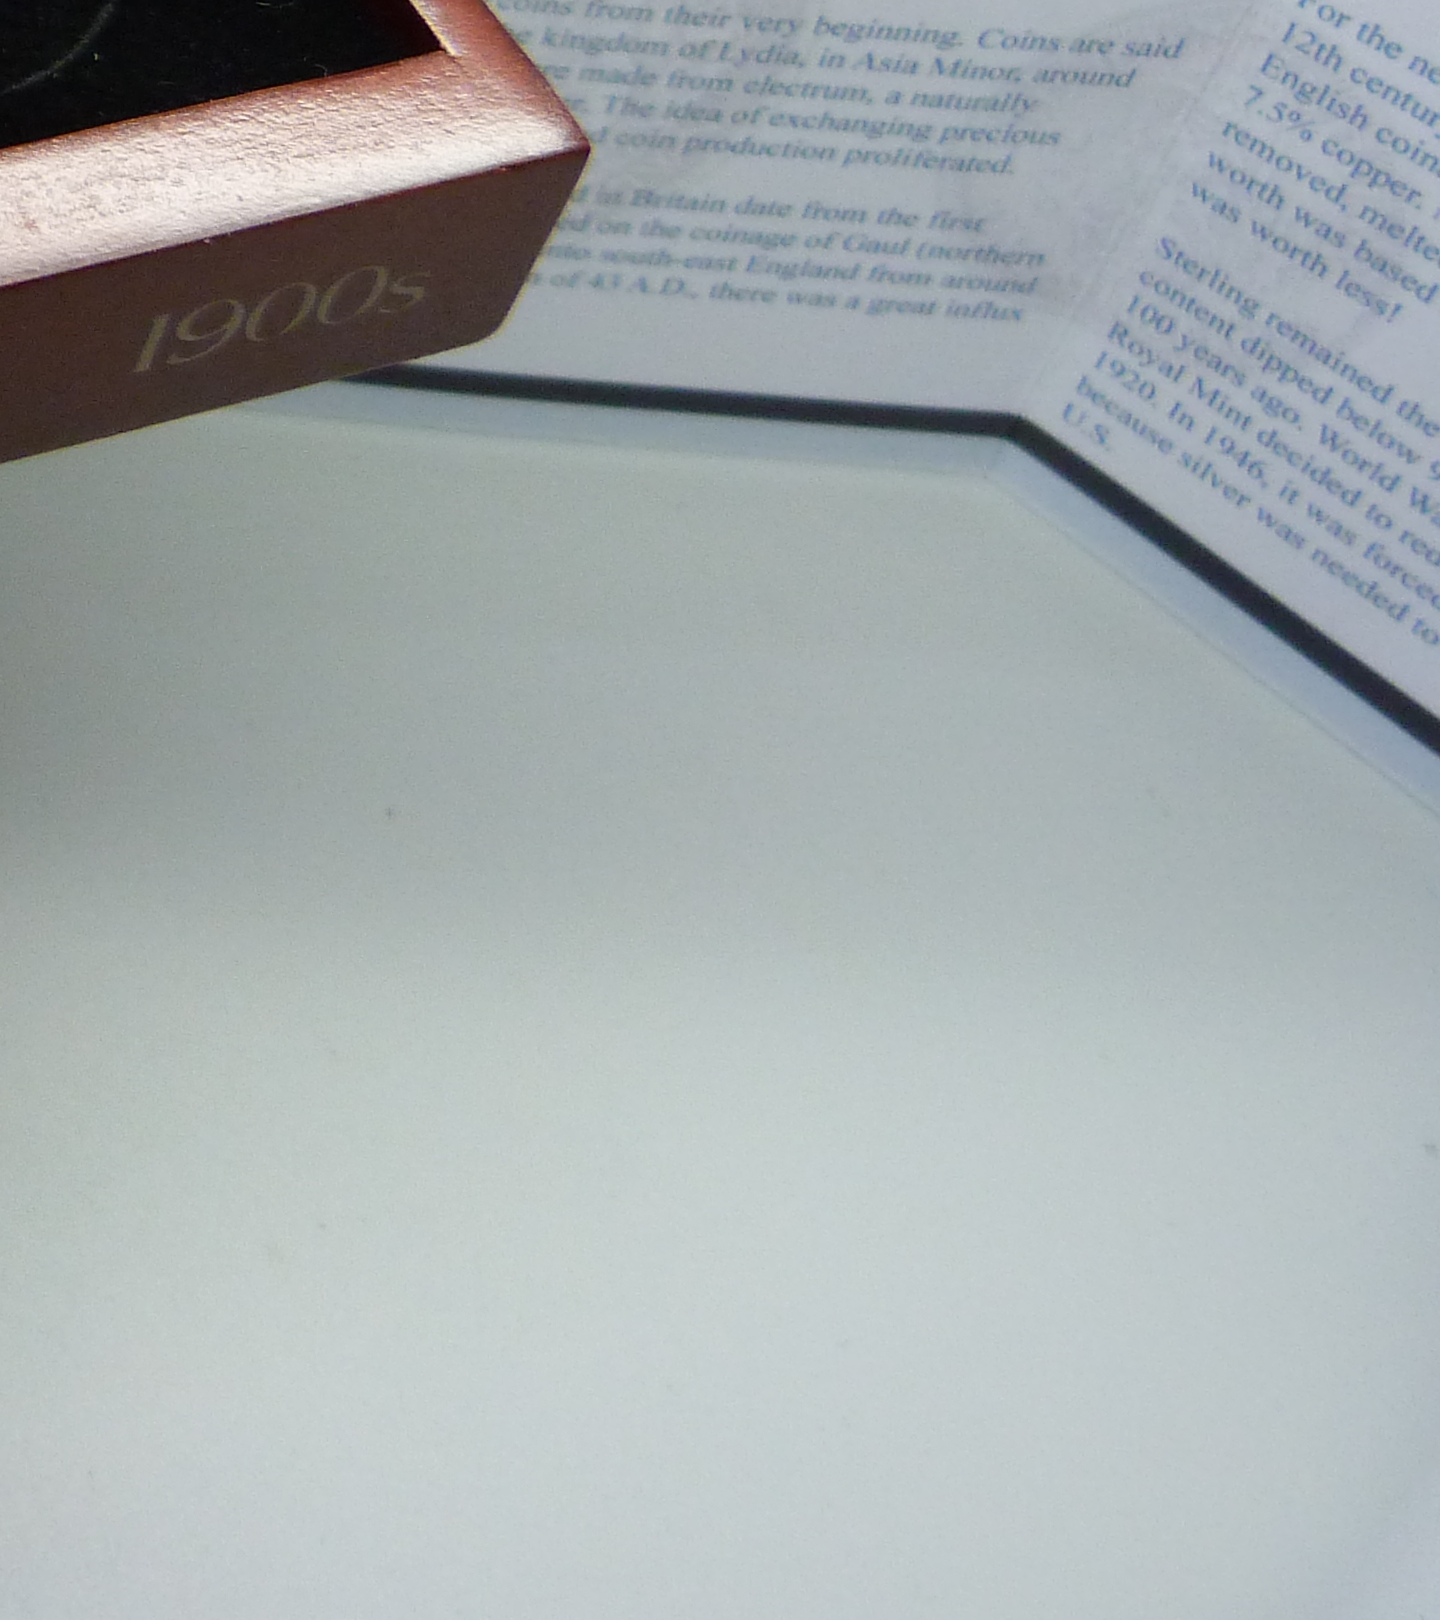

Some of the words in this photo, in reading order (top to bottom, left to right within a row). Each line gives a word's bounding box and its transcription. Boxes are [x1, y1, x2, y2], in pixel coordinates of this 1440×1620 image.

[1260, 53, 1368, 130] English
[1283, 22, 1343, 72] 12th
[1357, 23, 1404, 59] the
[133, 266, 434, 373] 1900s
[1193, 182, 1240, 223] was
[1252, 221, 1328, 278] worth
[1336, 270, 1403, 320] less!
[1140, 272, 1235, 340] content
[1241, 338, 1334, 403] dipped
[1337, 398, 1421, 464] below
[1156, 237, 1261, 319] Sterling
[1266, 313, 1395, 404] remained
[1108, 322, 1185, 381] Royal
[1191, 377, 1252, 431] Mint
[1258, 431, 1363, 505] decided
[1366, 504, 1393, 530] to
[1128, 295, 1175, 334] 100
[1173, 335, 1245, 387] years
[1251, 388, 1302, 430] ago.
[1320, 424, 1402, 492] World
